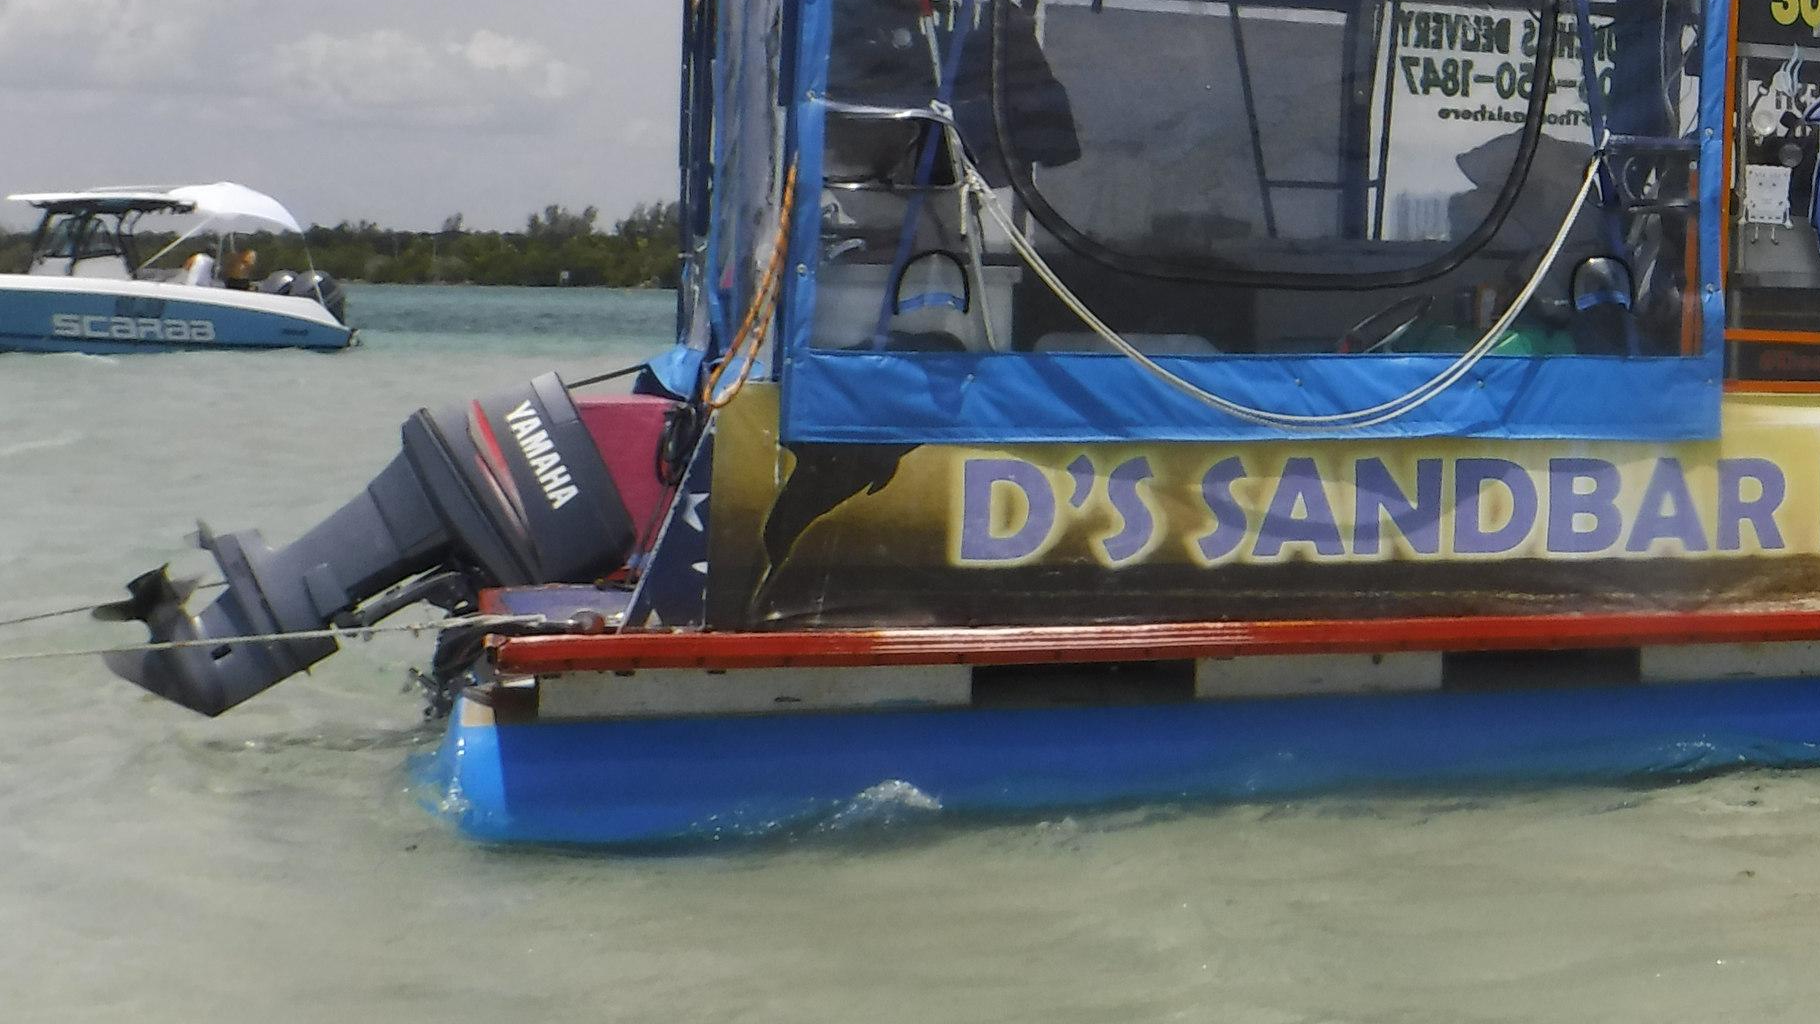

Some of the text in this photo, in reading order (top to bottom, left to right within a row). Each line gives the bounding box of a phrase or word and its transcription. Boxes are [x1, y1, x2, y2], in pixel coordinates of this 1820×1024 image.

[52, 314, 216, 341] SCARAB
[506, 399, 579, 510] YAMAHA
[959, 455, 1157, 567] D'S
[1197, 454, 1787, 566] SANDBAR
